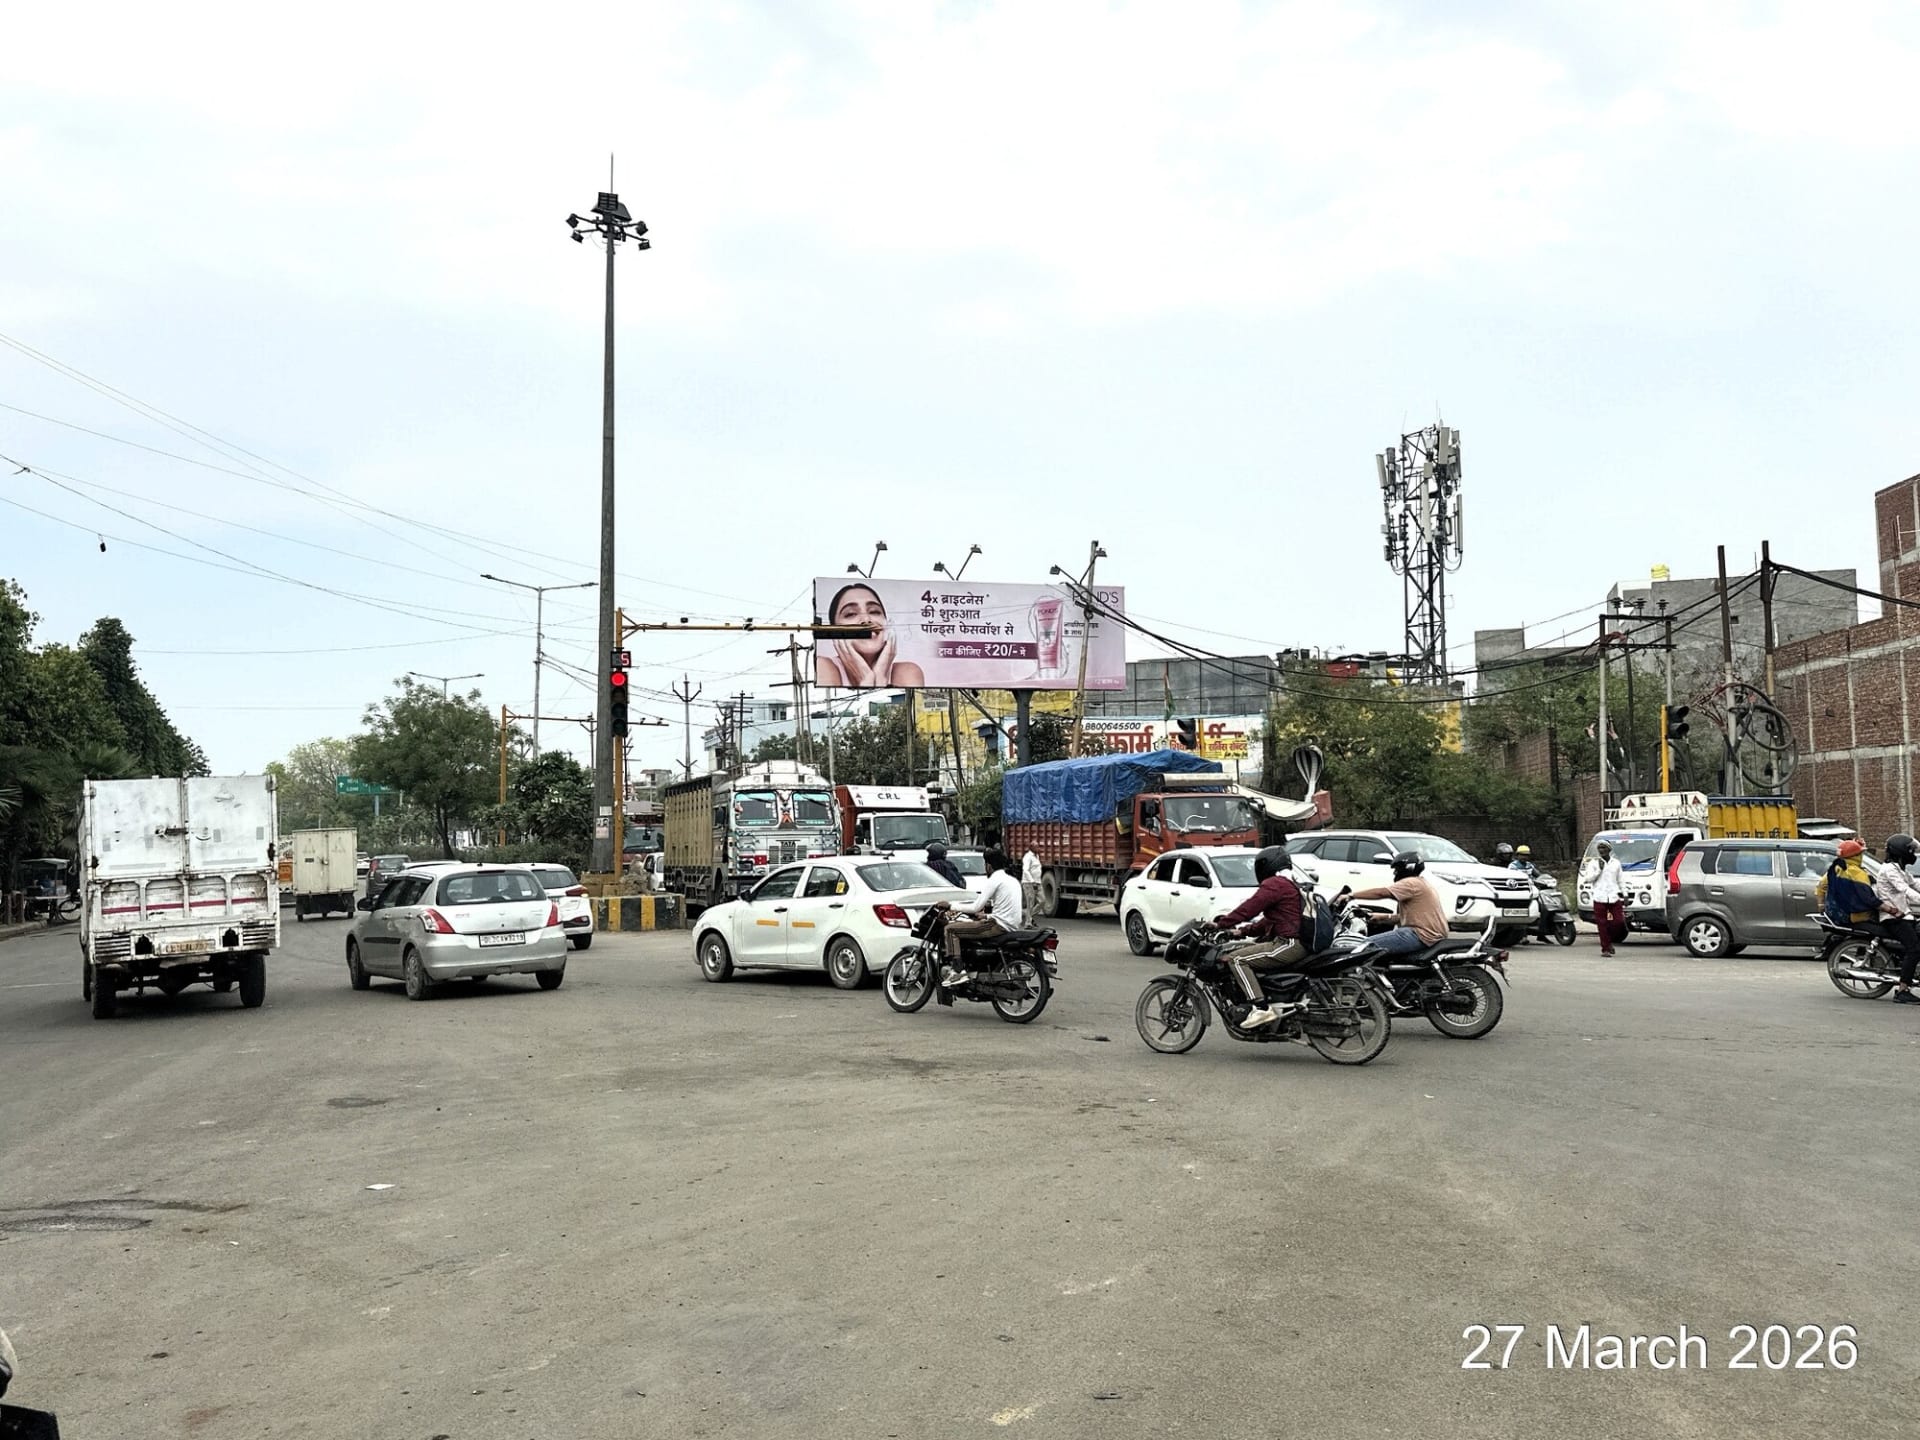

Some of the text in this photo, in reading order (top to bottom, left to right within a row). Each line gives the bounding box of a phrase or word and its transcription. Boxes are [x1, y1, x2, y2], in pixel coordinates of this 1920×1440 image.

[921, 590, 938, 604] 4x
[921, 605, 980, 622] की शुरुआत
[921, 621, 1014, 637] पॉन्ड्स फेसवॉश से
[955, 645, 981, 657] कीजिए
[985, 643, 1018, 656] ₹20/-
[1085, 722, 1141, 731] 8800645500
